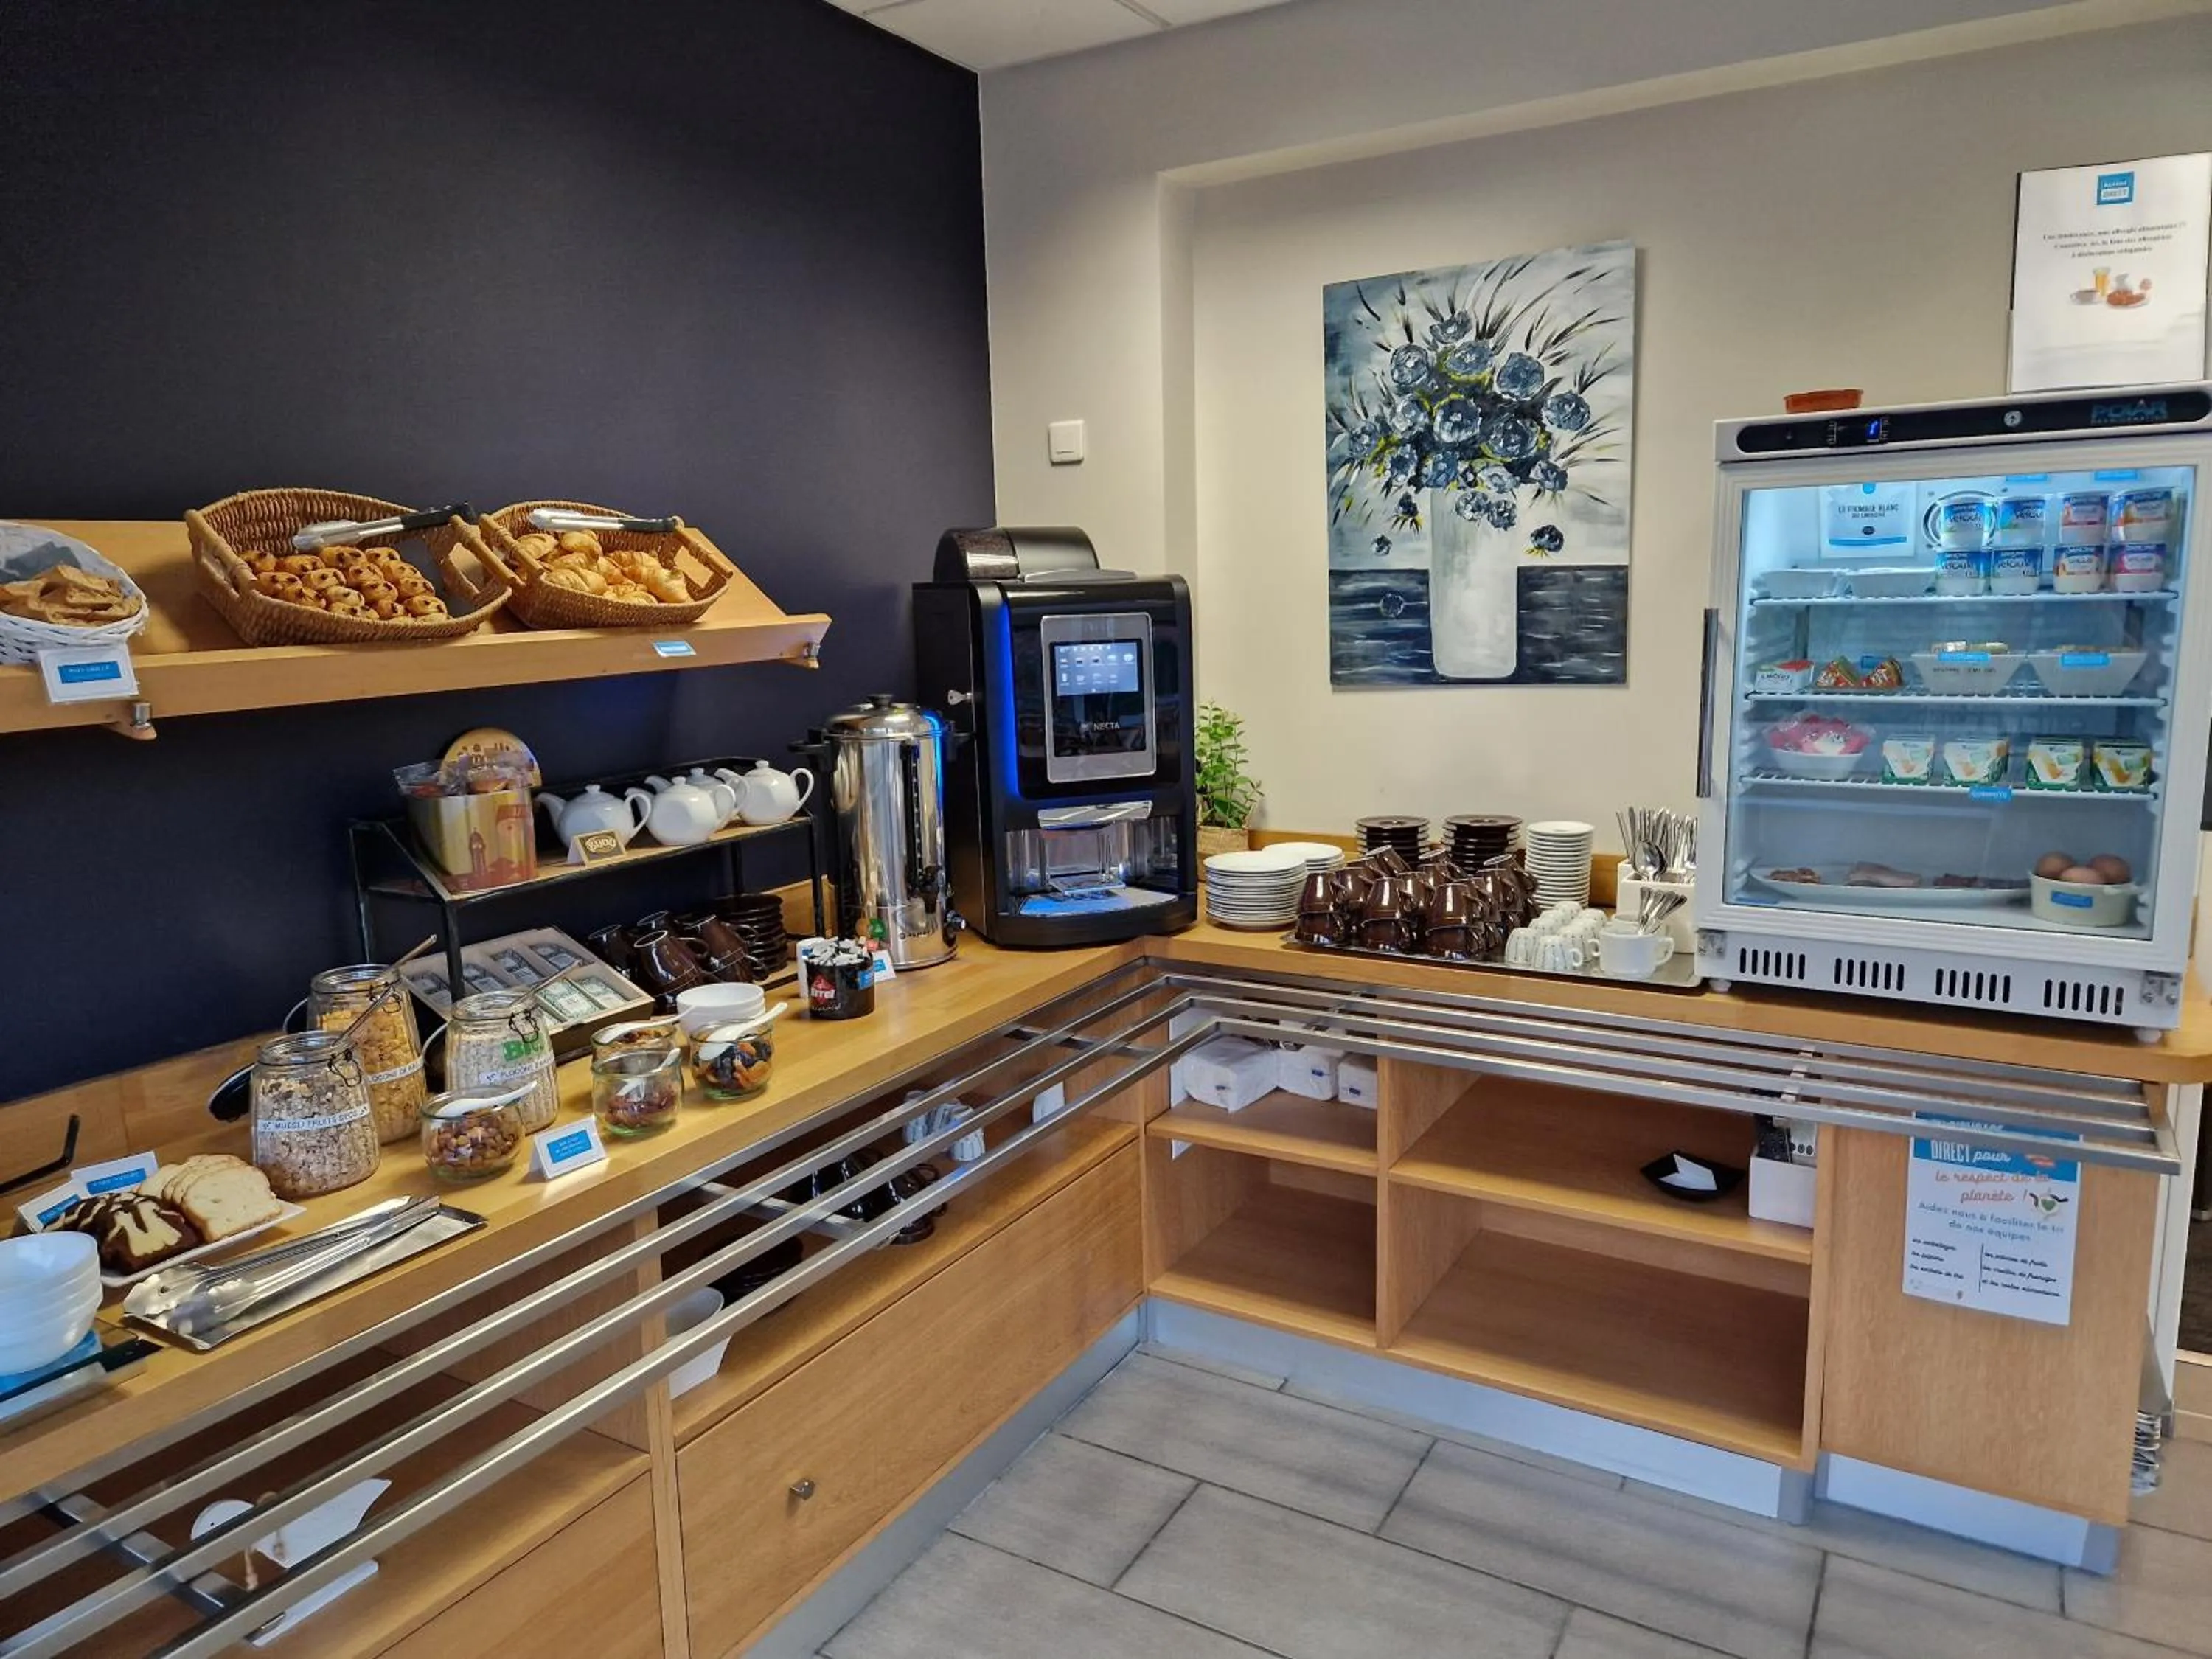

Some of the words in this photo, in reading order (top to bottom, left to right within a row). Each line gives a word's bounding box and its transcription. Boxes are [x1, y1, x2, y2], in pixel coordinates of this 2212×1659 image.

[1093, 722, 1120, 731] NECTA
[307, 1116, 337, 1127] FRUITS
[1972, 1150, 2011, 1163] pour
[1954, 1171, 2007, 1185] respect
